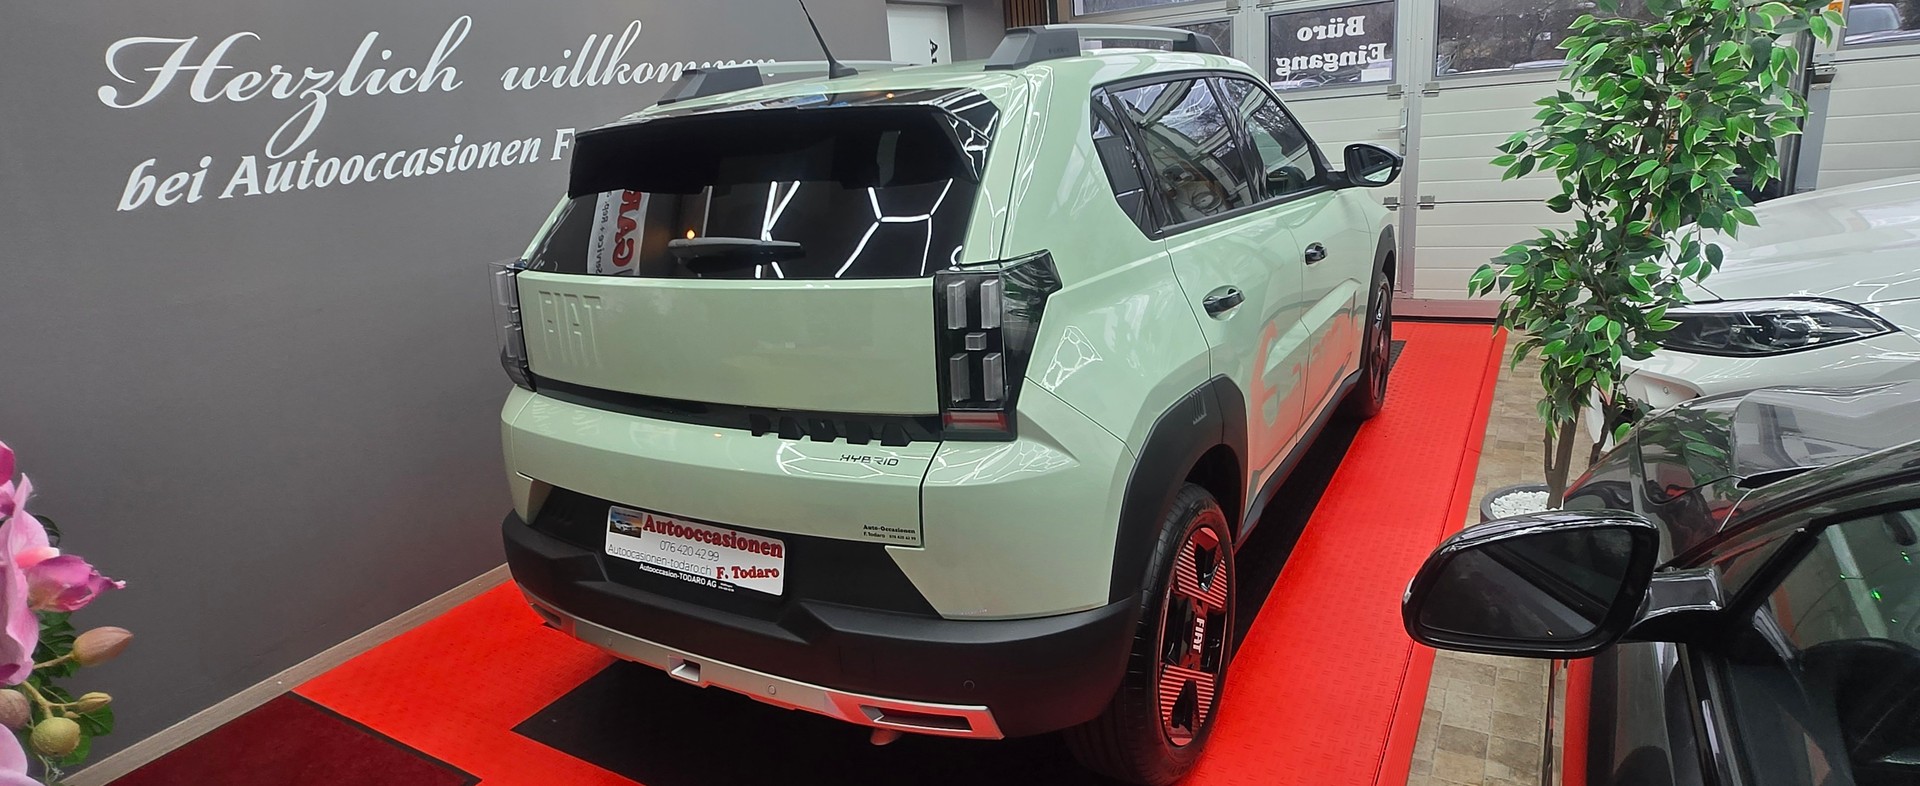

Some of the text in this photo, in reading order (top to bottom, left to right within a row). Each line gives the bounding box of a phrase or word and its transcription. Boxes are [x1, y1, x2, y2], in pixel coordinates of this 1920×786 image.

[97, 15, 776, 159] Herzlich willkom
[116, 155, 213, 212] bei
[218, 133, 543, 200] Autooccasionen
[538, 290, 603, 366] FIAT
[839, 453, 899, 467] HYBRID
[642, 514, 784, 559] Autooccasionen
[659, 540, 720, 562] 076 420 42 99
[706, 580, 717, 589] AG
[716, 565, 780, 580] F. Todaro
[1193, 617, 1205, 653] FIAT
